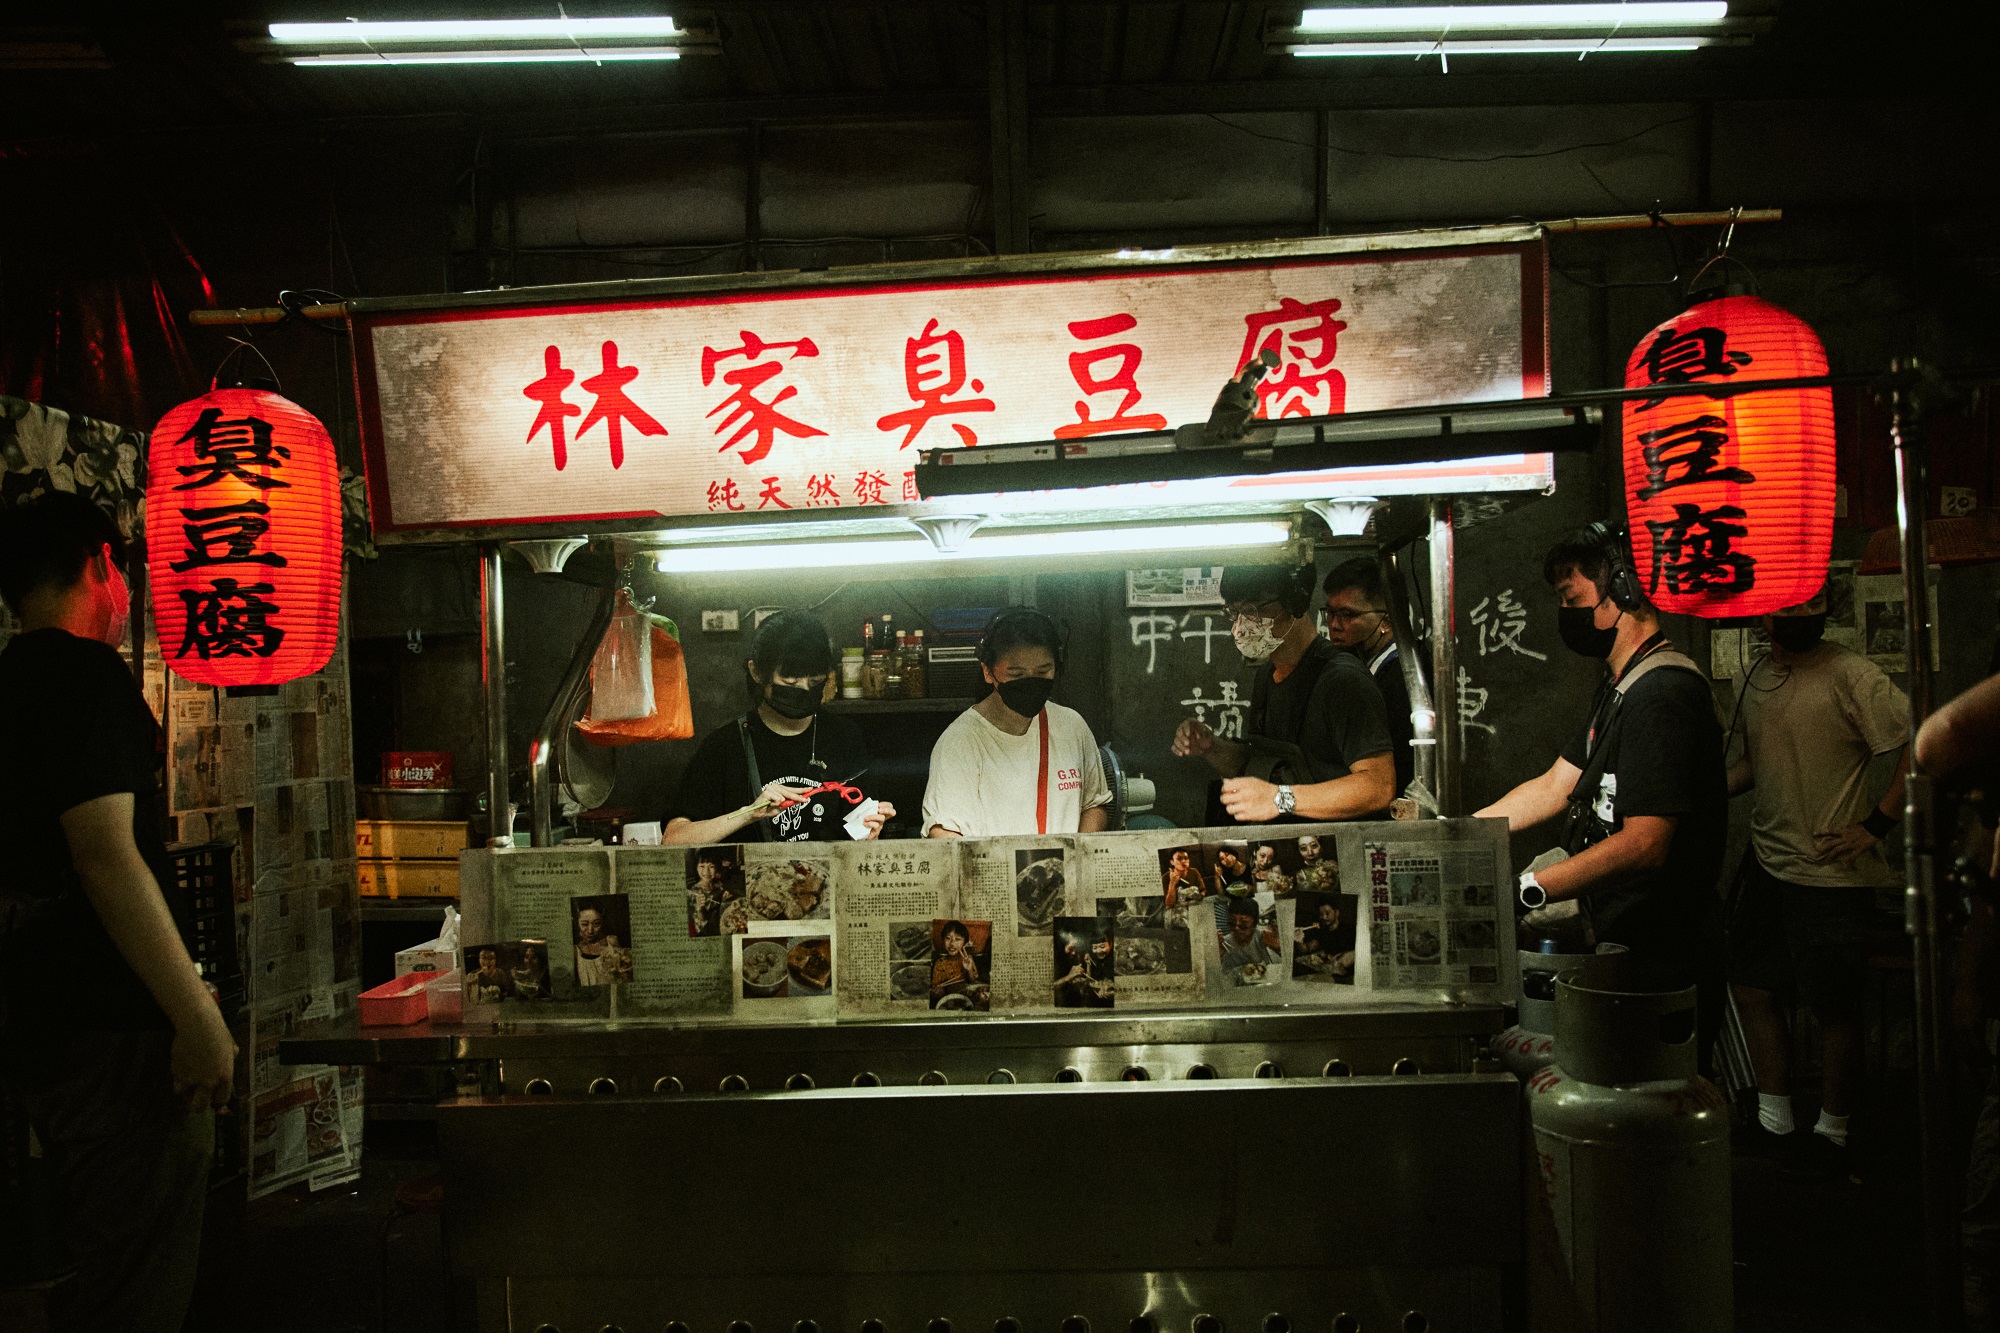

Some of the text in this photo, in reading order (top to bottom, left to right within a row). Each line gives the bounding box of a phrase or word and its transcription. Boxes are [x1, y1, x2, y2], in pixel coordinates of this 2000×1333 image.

[522, 297, 1348, 473] 林家臭豆腐
[1634, 326, 1757, 595] 臭豆腐
[169, 407, 292, 661] 臭豆腐
[1469, 588, 1547, 661] 後
[785, 775, 799, 783] WITH
[797, 832, 809, 841] YOU
[857, 860, 931, 876] 林家臭豆腐
[1370, 852, 1390, 922] 宵夜指南
